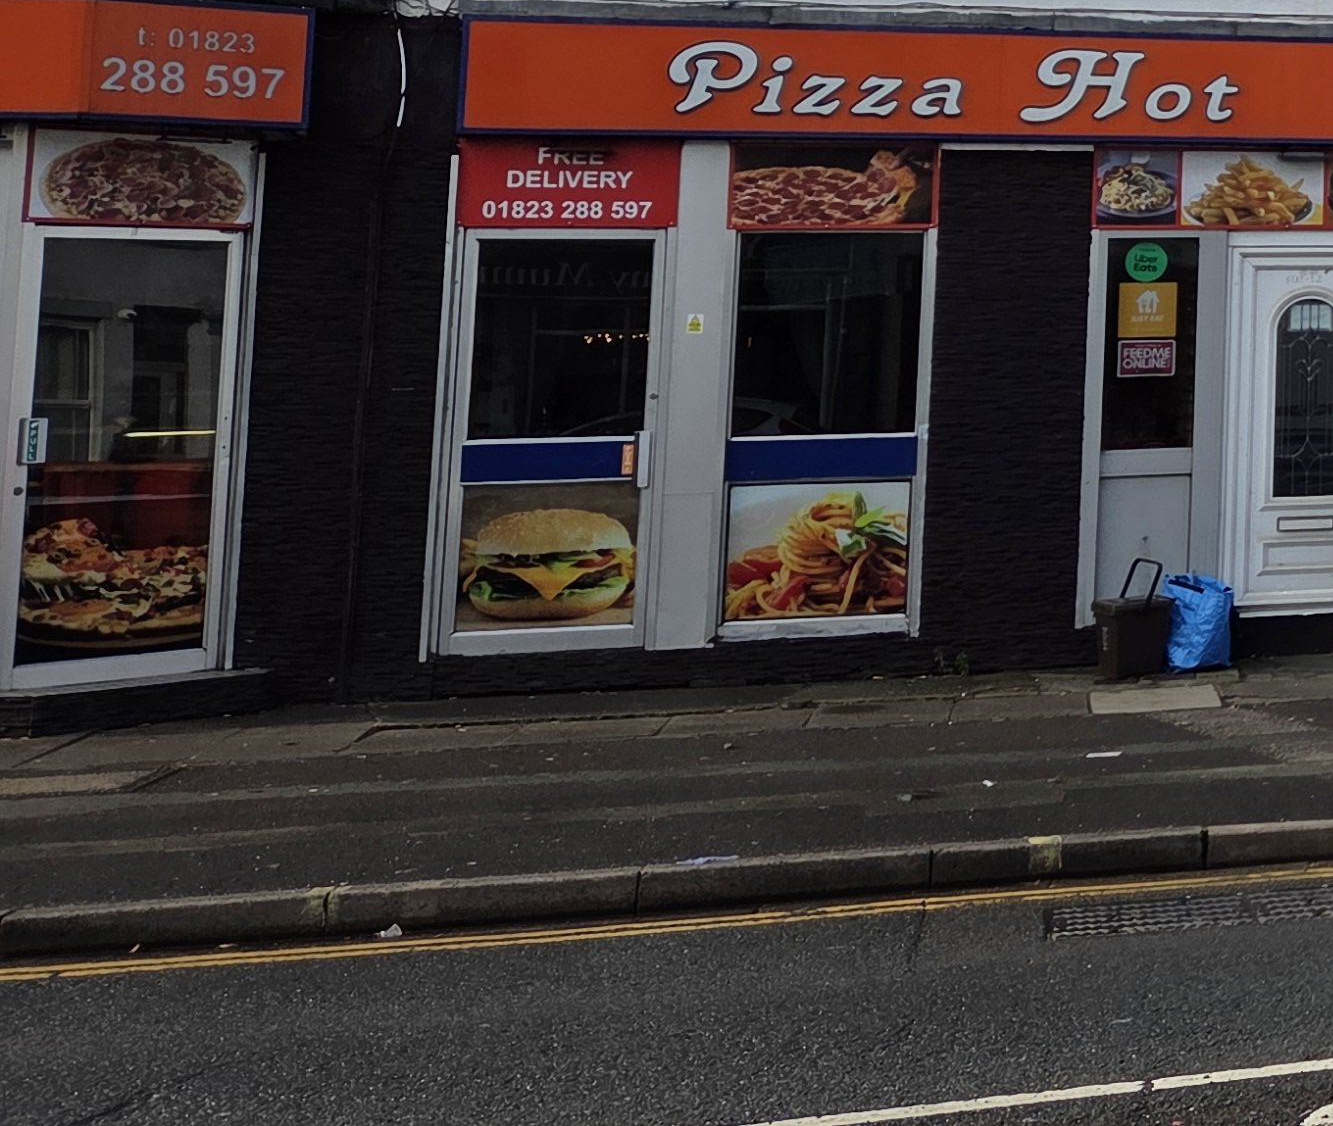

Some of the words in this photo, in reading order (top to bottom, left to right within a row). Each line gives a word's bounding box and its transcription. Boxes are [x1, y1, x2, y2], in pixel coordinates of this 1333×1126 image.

[168, 27, 255, 54] 01823
[100, 57, 185, 95] 288
[203, 64, 286, 100] 597
[668, 40, 963, 117] Pizza
[1018, 48, 1240, 124] Hot
[537, 147, 605, 166] FREE
[506, 170, 634, 190] DELIVERY
[482, 200, 554, 219] 01823
[560, 200, 604, 219] 288
[610, 201, 653, 220] 597
[1133, 263, 1158, 272] Eats
[1134, 254, 1158, 263] Uber
